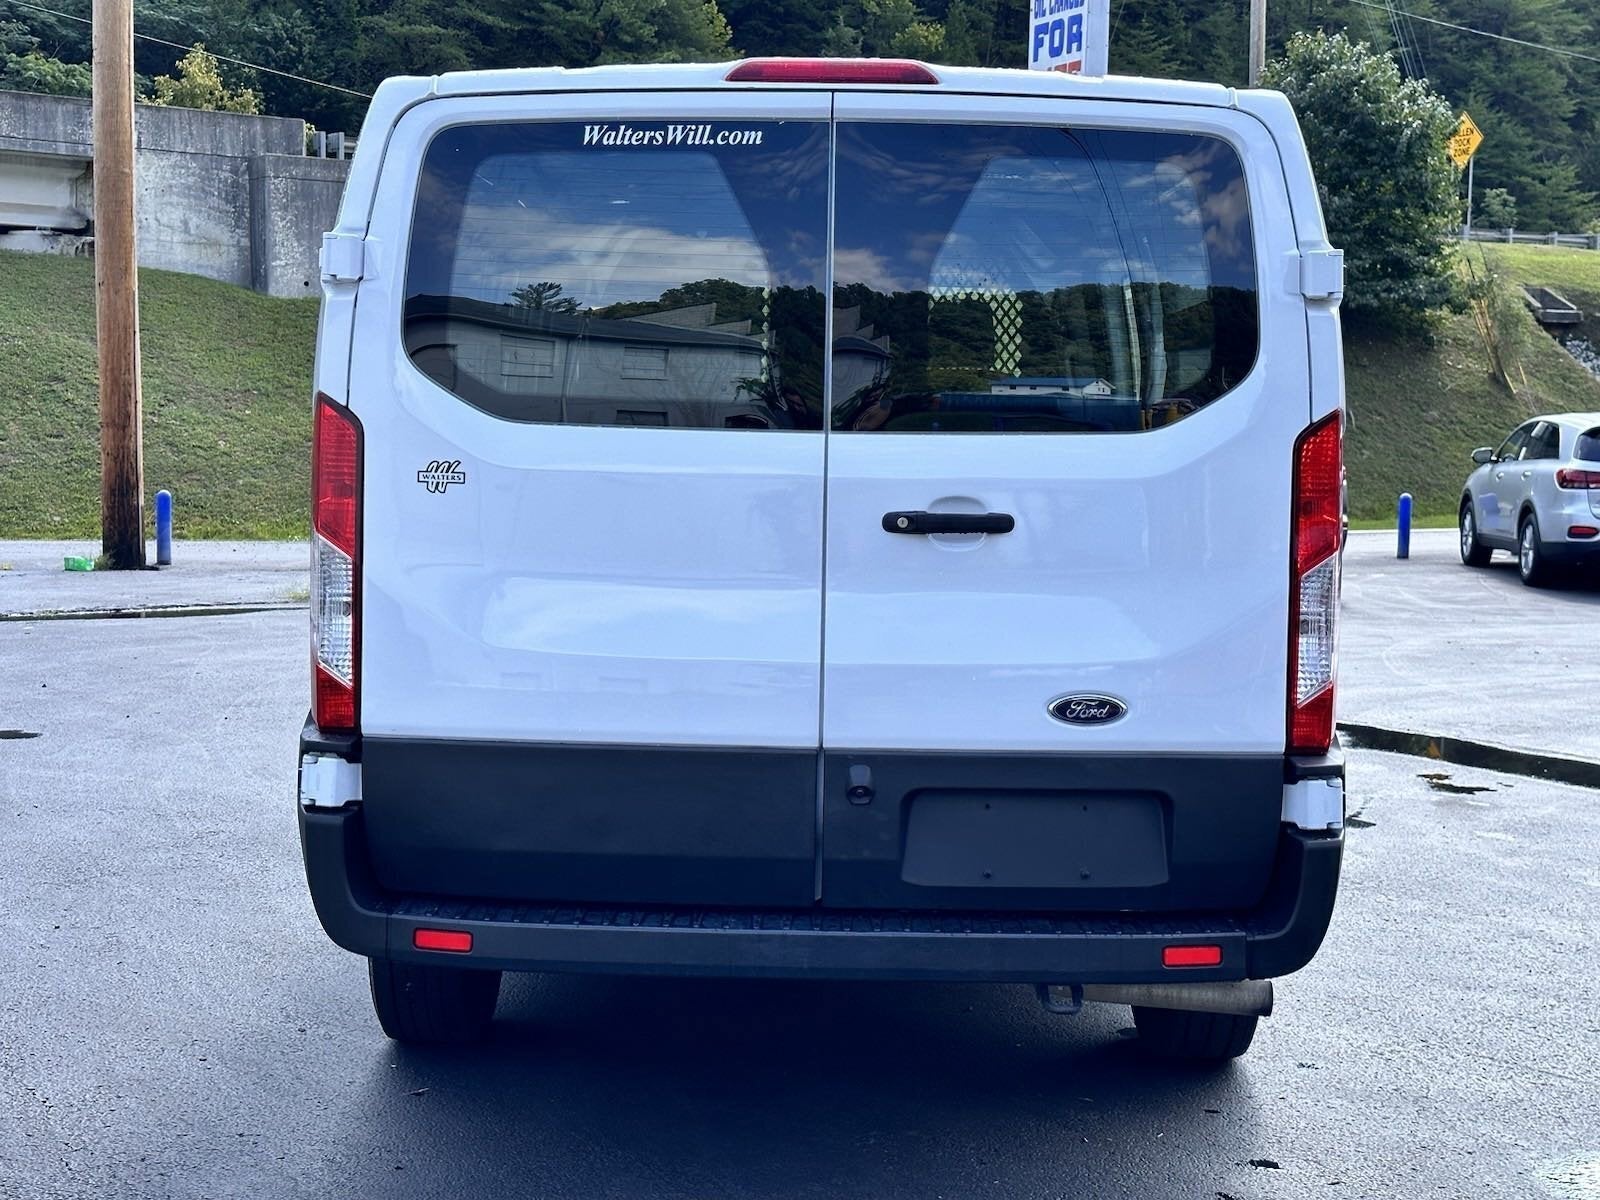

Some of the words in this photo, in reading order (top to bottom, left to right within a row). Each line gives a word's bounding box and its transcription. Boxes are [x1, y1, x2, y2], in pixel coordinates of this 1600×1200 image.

[1033, 13, 1083, 63] FOR
[583, 124, 763, 146] WaltersWill.com
[422, 473, 462, 481] WALTERS
[1066, 700, 1110, 718] Ford
